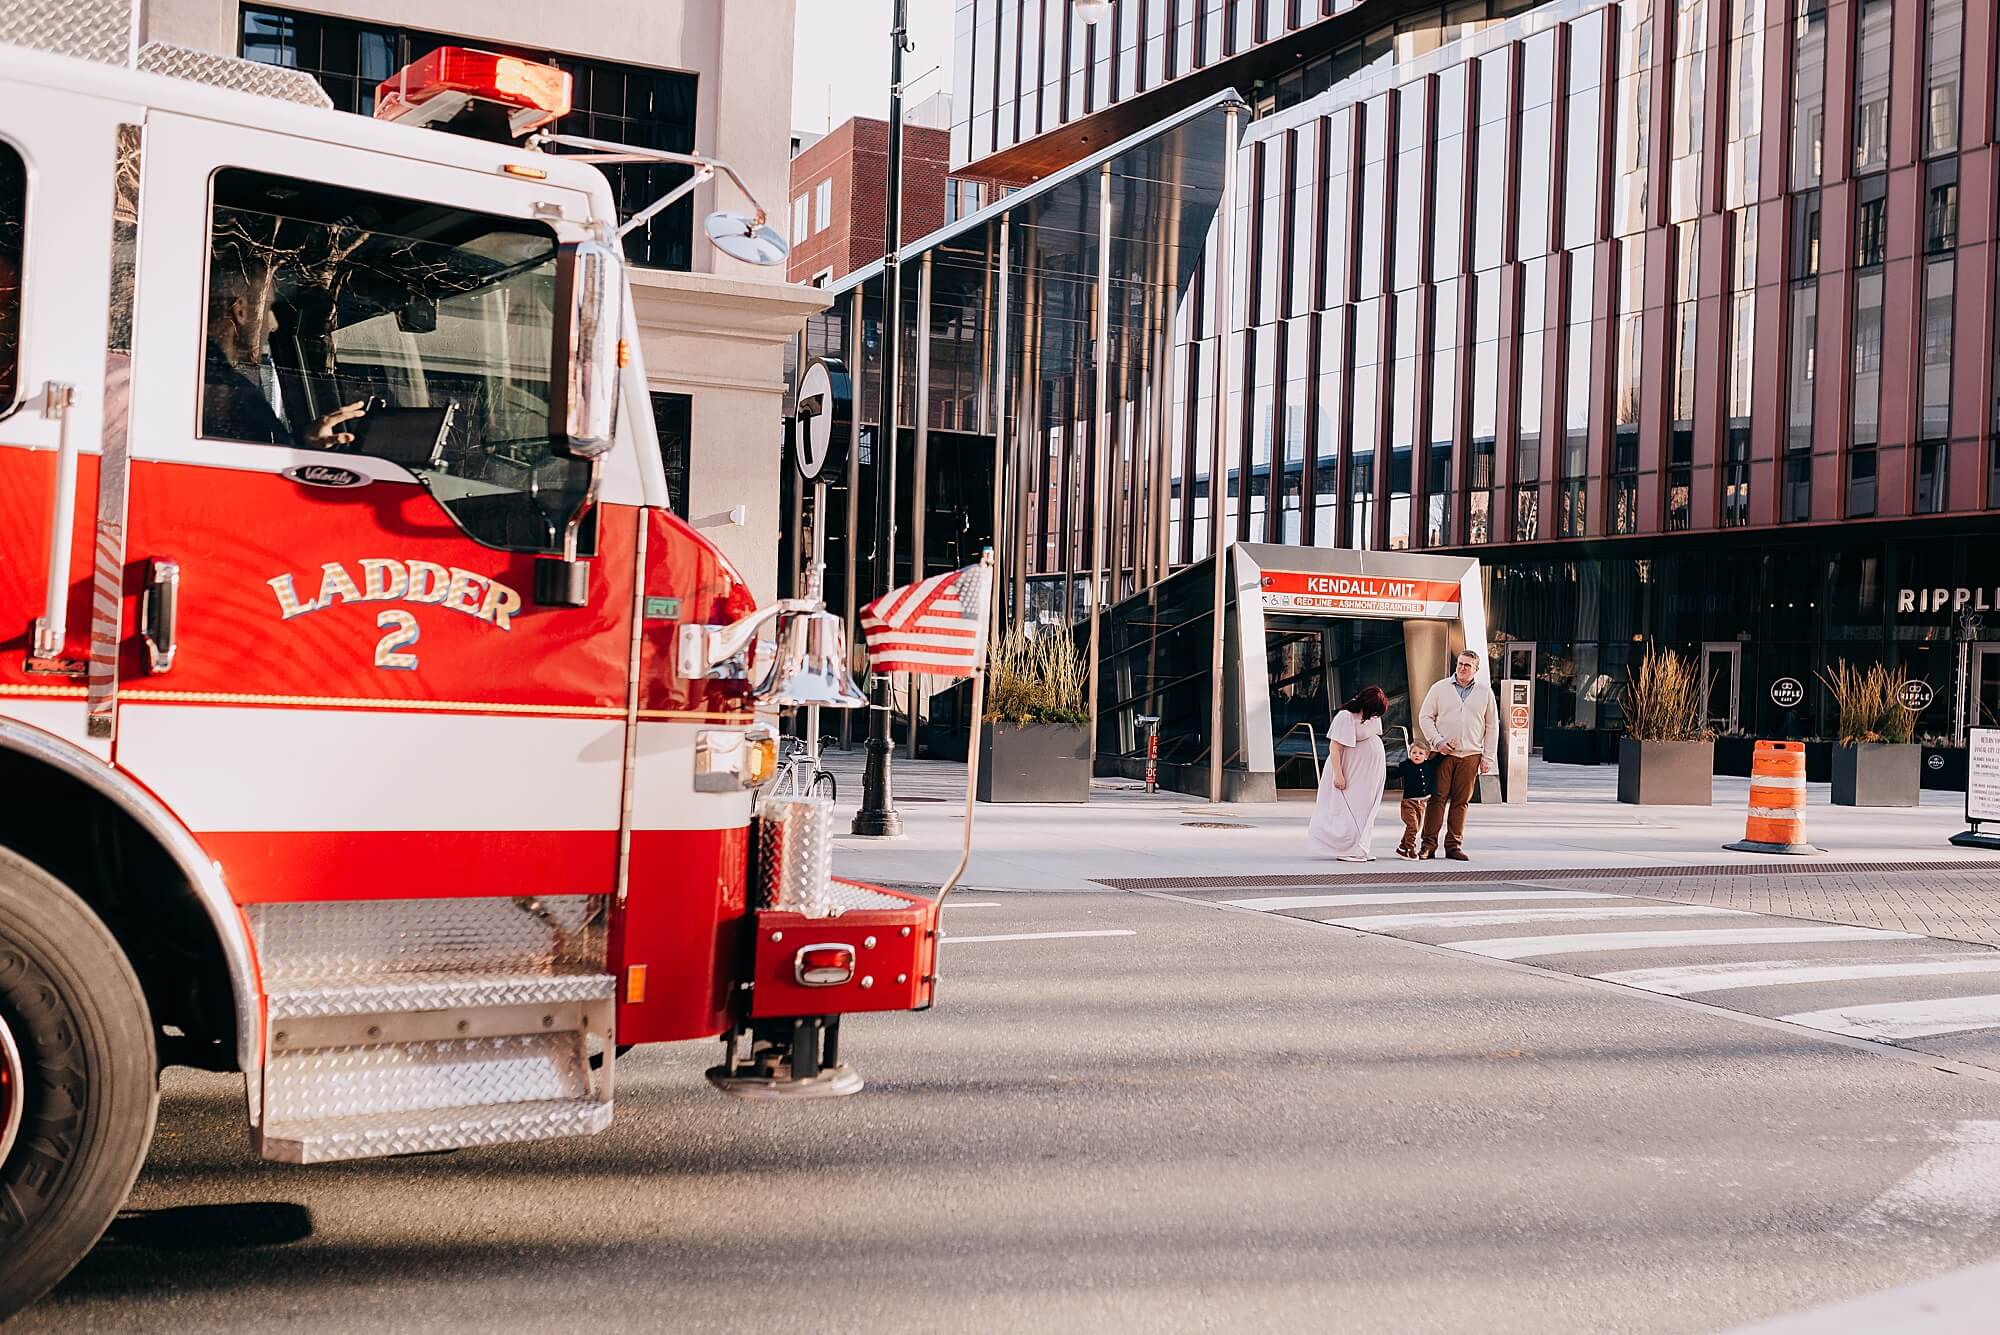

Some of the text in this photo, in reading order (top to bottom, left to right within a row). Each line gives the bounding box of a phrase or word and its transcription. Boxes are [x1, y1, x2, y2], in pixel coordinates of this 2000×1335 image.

[797, 392, 825, 465] T
[266, 558, 522, 632] LADDER
[1296, 597, 1313, 607] RED
[1314, 599, 1333, 608] LINE
[1307, 577, 1378, 597] KENDALL
[1388, 582, 1416, 598] MIT
[374, 609, 420, 671] 2
[1773, 689, 1801, 698] RIPPLE
